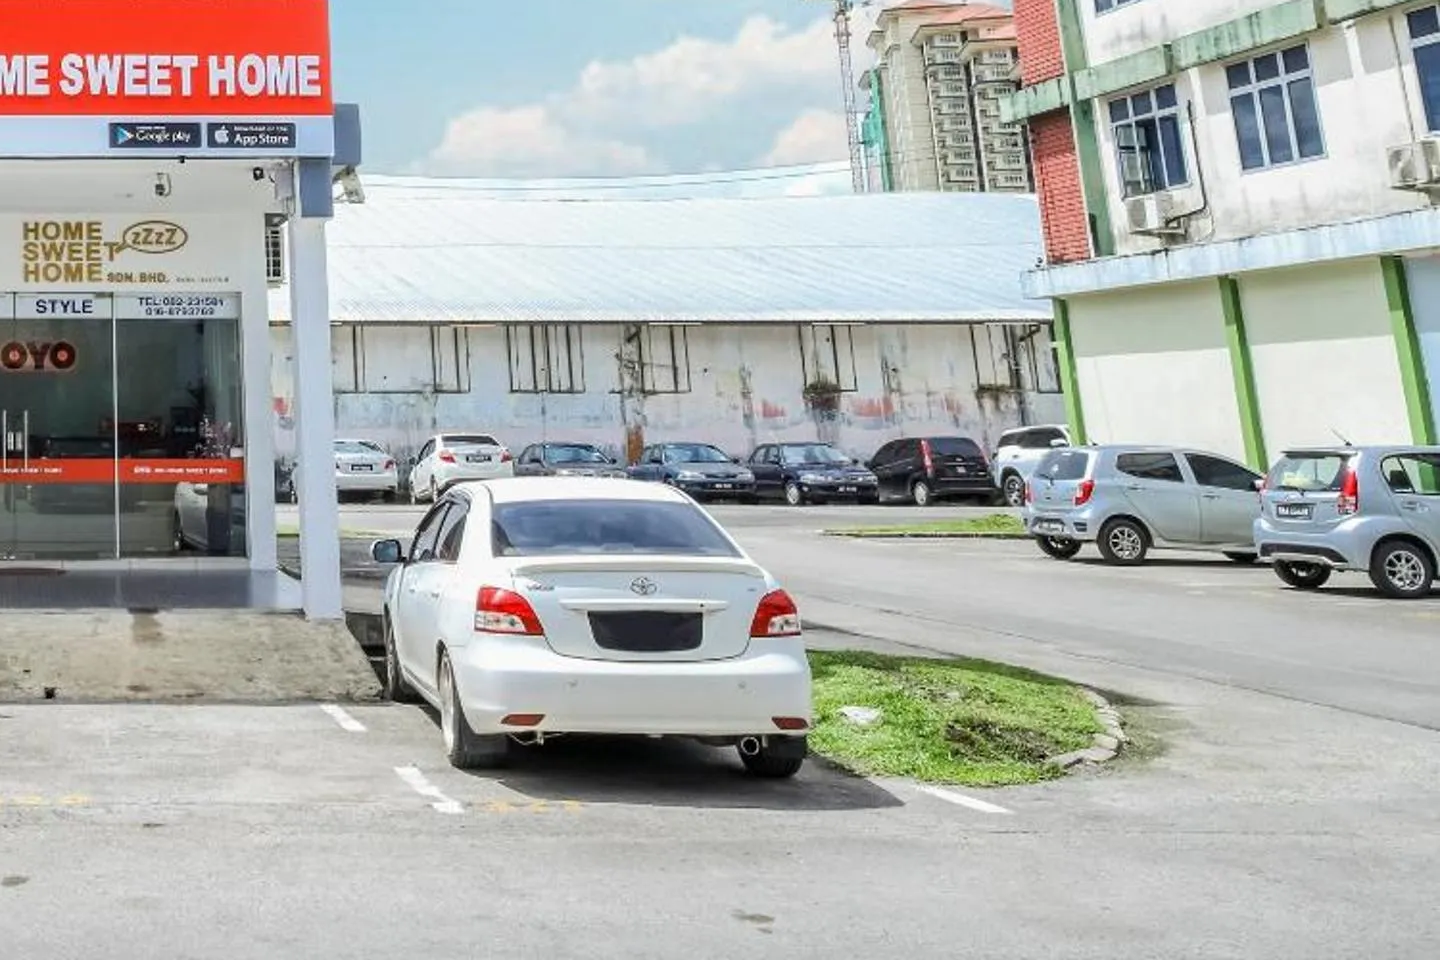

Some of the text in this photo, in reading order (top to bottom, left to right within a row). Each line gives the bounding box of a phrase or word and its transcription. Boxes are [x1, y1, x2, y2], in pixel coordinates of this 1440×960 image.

[60, 54, 197, 97] SWEET
[209, 55, 322, 96] HOME
[135, 130, 170, 143] Google
[233, 133, 289, 145] App Store
[23, 221, 102, 240] HOME
[22, 241, 119, 262] SWEET
[23, 262, 103, 283] HOME
[107, 272, 137, 283] SDN.
[139, 272, 170, 283] BHD.
[35, 298, 94, 314] STYLE
[0, 341, 77, 370] OYO
